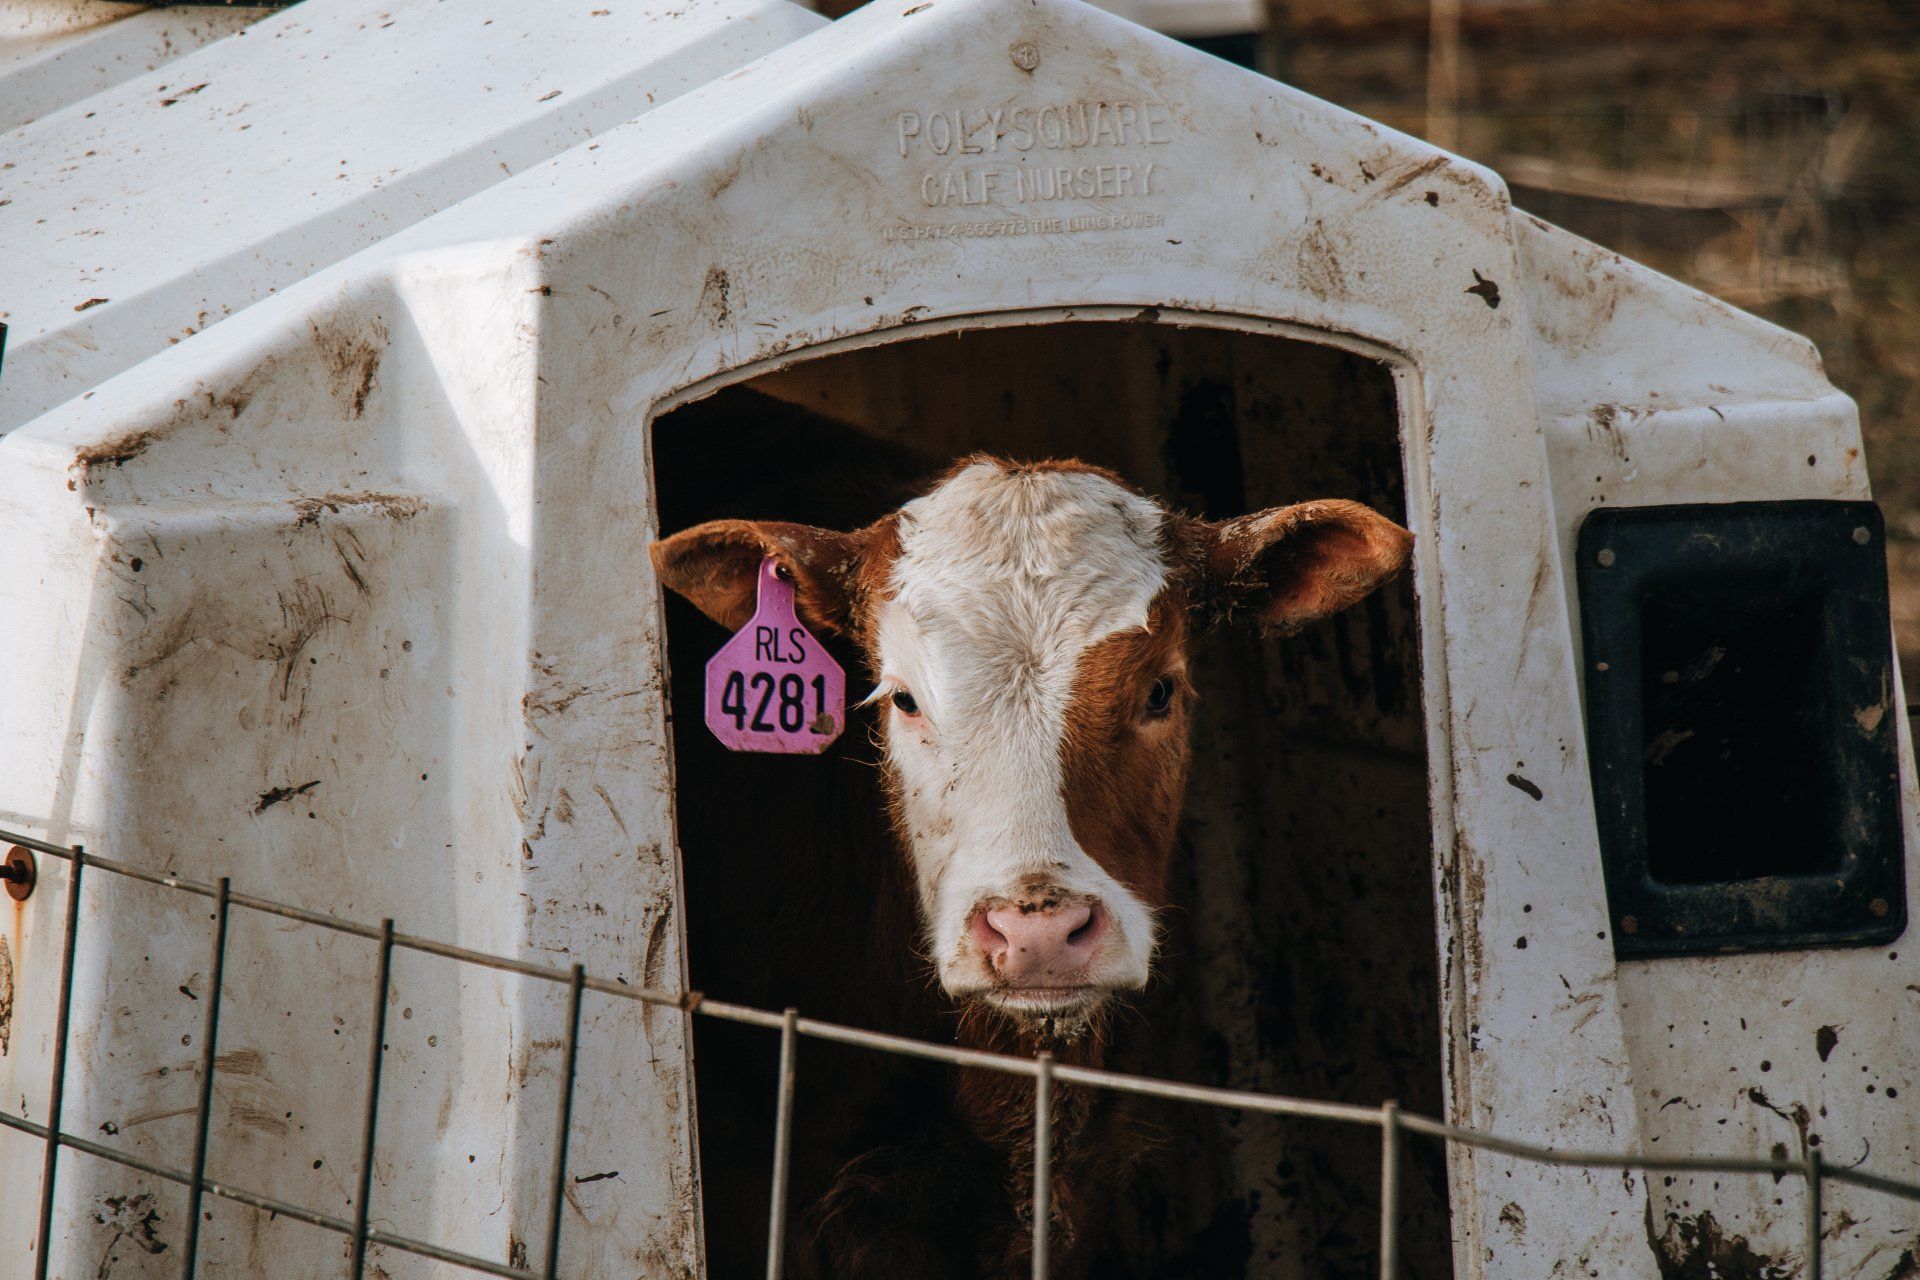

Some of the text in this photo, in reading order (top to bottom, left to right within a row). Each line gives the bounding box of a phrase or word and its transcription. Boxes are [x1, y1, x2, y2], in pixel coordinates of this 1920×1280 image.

[898, 101, 1171, 157] POLYSQUARE
[921, 162, 1156, 207] CALF NURSERY
[1031, 218, 1061, 233] THE
[756, 626, 805, 663] RLS
[722, 671, 827, 734] 4281
